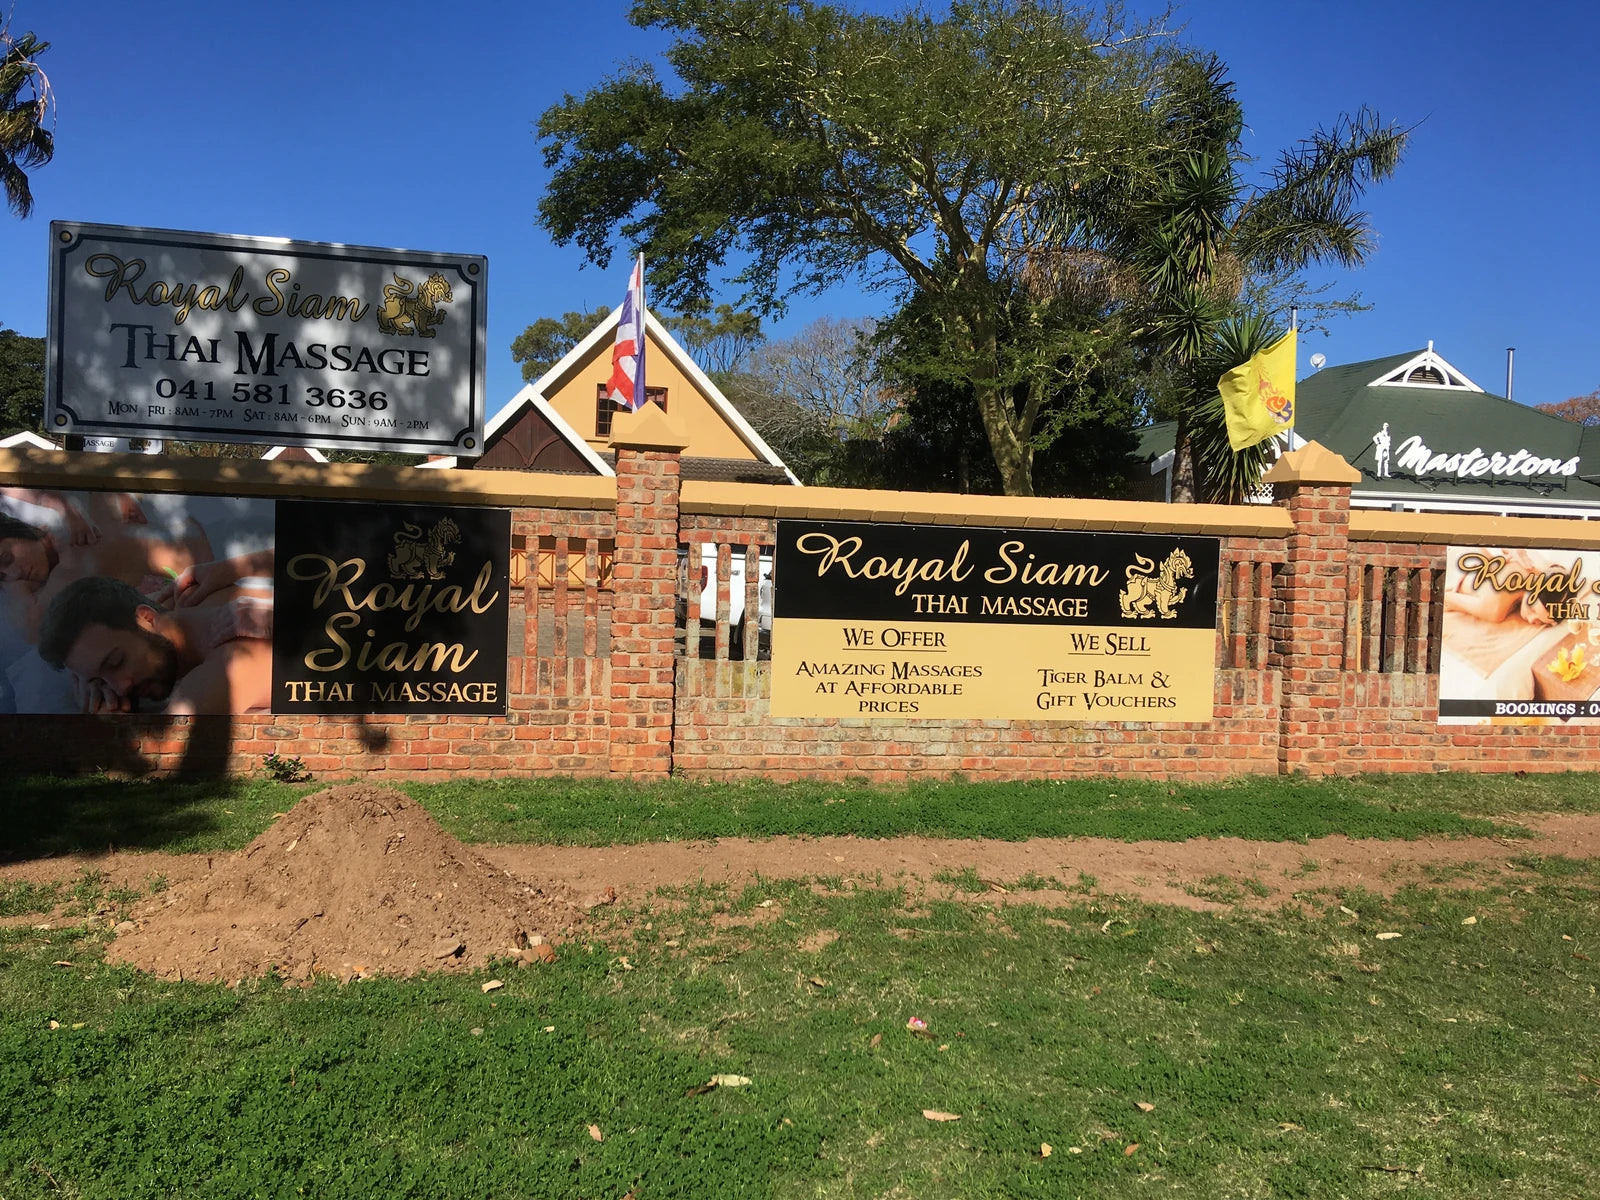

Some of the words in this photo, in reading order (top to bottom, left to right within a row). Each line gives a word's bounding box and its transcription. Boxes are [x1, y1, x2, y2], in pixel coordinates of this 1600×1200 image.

[85, 253, 249, 325] Royal
[253, 268, 370, 322] Siam
[109, 323, 221, 369] THAI
[233, 330, 430, 377] MASSAGE
[156, 378, 216, 401] 041
[232, 382, 291, 405] 581
[305, 387, 388, 411] 3636
[1395, 435, 1580, 477] Mastertons
[796, 532, 974, 596] Royal
[984, 541, 1109, 587] Siam
[1458, 553, 1586, 605] Royal
[287, 553, 499, 632] Royal
[912, 594, 968, 614] THAI
[981, 596, 1088, 617] MASSAGE
[1546, 602, 1590, 620] THAI
[304, 611, 479, 673] Siam
[843, 628, 874, 646] WE
[881, 628, 947, 648] OFFER
[1070, 633, 1100, 651] WE
[1105, 633, 1151, 655] SELL
[796, 661, 885, 678] AMAZING
[891, 662, 982, 680] MASSAGES
[1038, 669, 1087, 687] TIGER
[1094, 670, 1143, 687] BALM
[1151, 671, 1171, 688] &
[284, 681, 356, 702] THAI
[369, 682, 498, 703] MASSAGE
[815, 682, 838, 694] AT
[844, 681, 963, 697] AFFORDABLE
[859, 701, 919, 713] PRICES
[1037, 692, 1076, 710] GIFT
[1083, 693, 1176, 710] VOUCHERS
[1495, 703, 1576, 716] BOOKINGS
